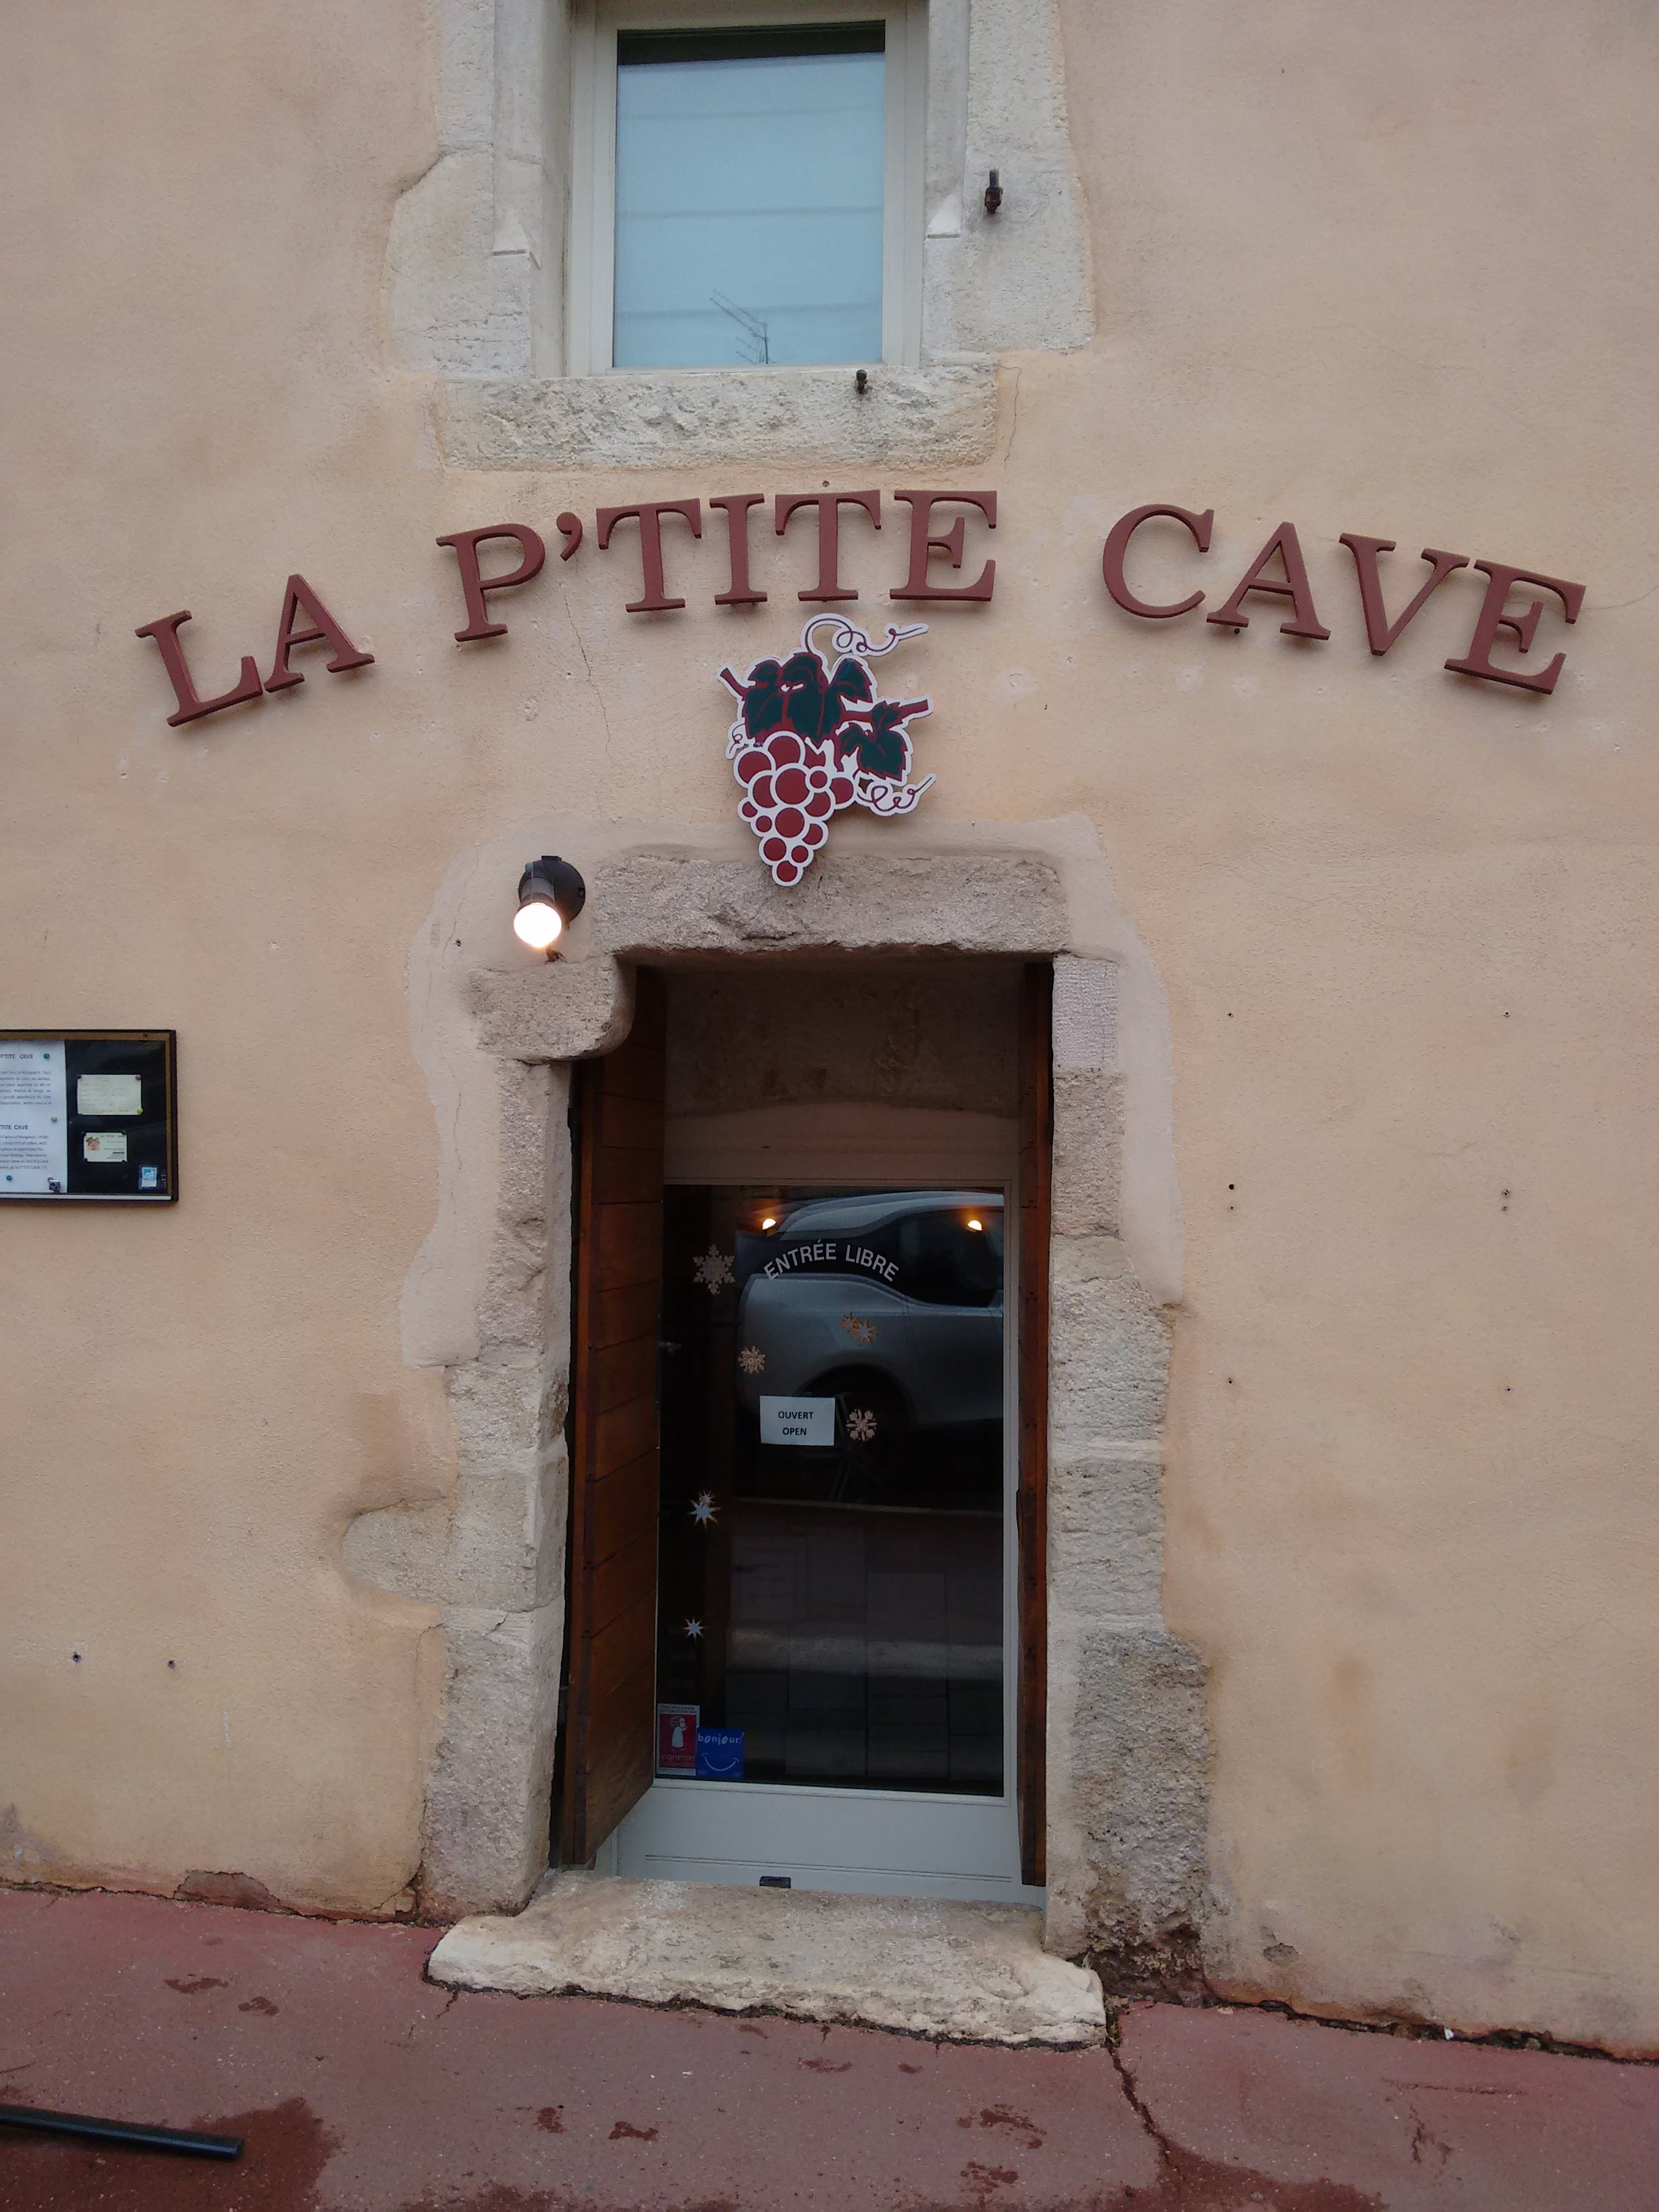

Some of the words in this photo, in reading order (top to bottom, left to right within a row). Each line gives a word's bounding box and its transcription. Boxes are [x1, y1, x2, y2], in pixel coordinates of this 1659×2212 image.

[136, 573, 375, 728] LA
[1102, 504, 1587, 695] CAVE
[764, 1240, 837, 1280] ENTRÉE
[845, 1244, 899, 1282] LIBRE
[778, 1410, 814, 1420] OUVERT
[782, 1427, 807, 1436] OPEN
